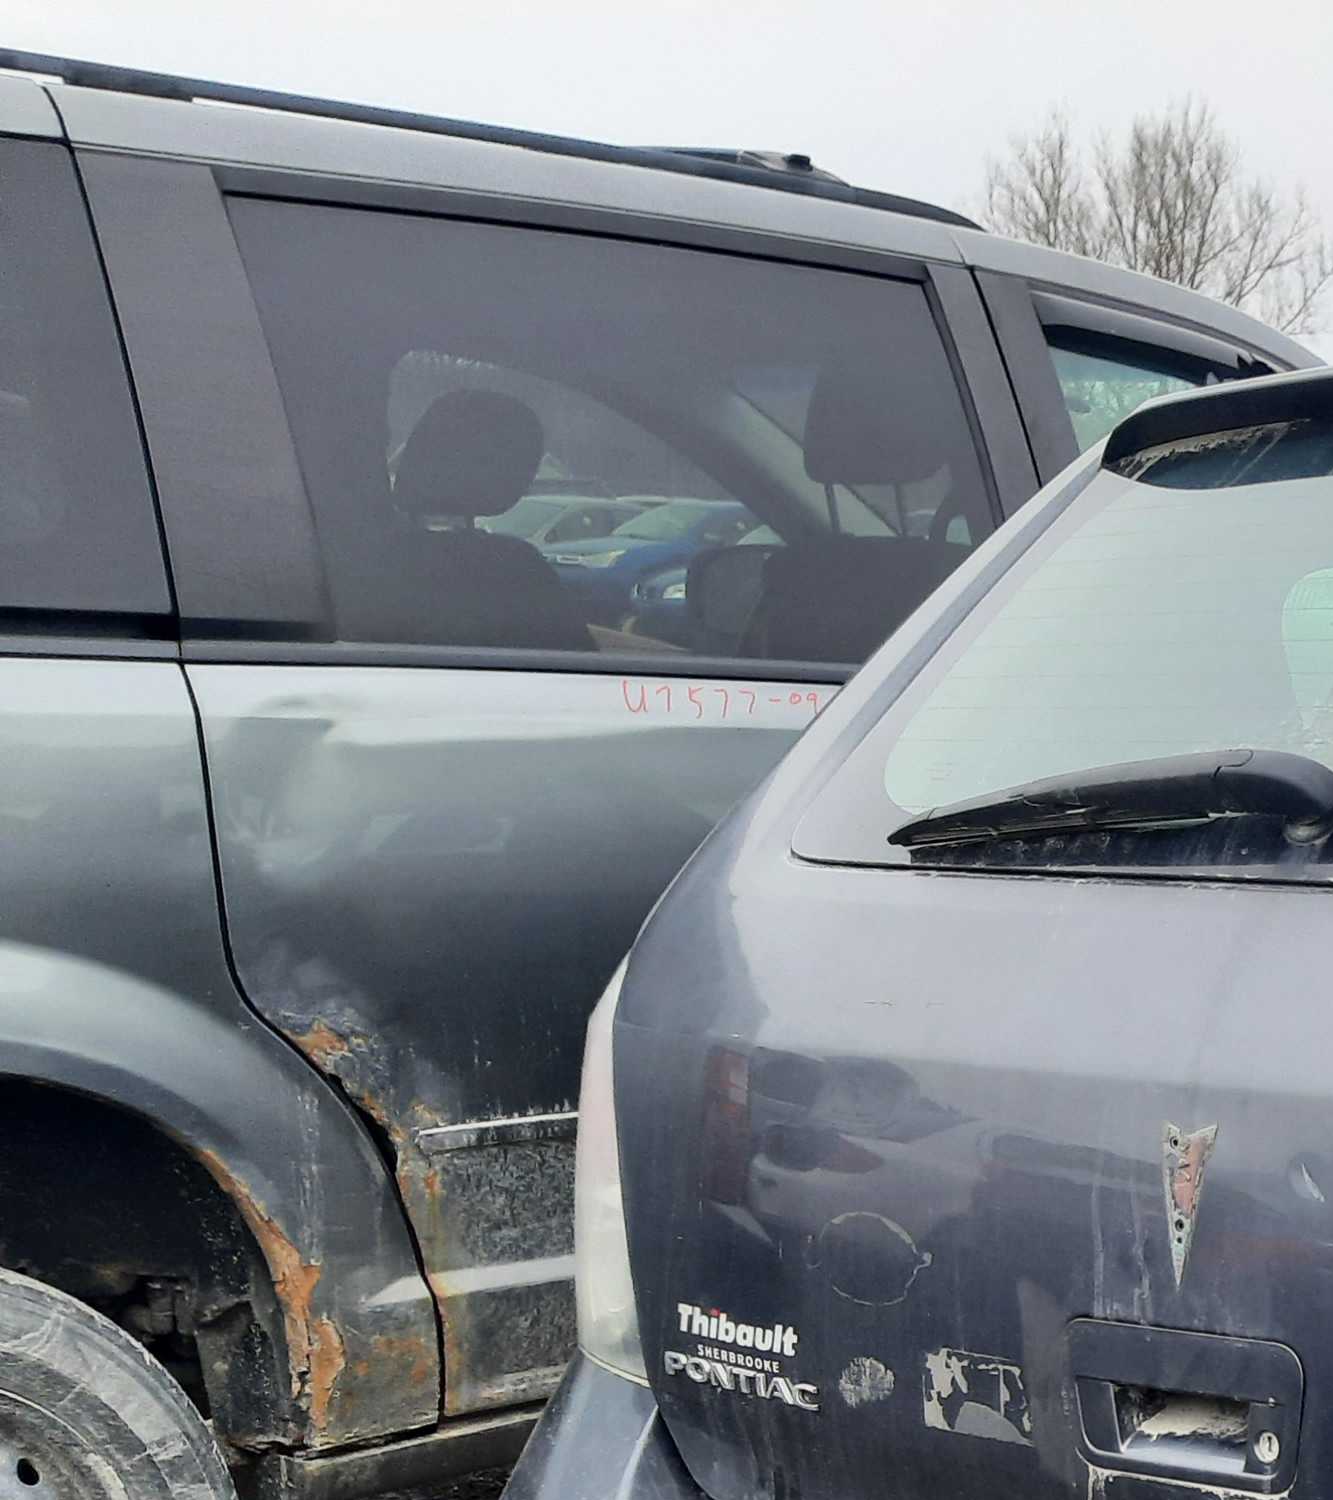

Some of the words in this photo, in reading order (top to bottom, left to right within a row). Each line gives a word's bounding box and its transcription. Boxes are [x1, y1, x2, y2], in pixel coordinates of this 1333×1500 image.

[677, 1302, 798, 1357] Thibault
[664, 1350, 820, 1411] PONTIAC
[697, 1344, 780, 1374] SHERBROOKE
